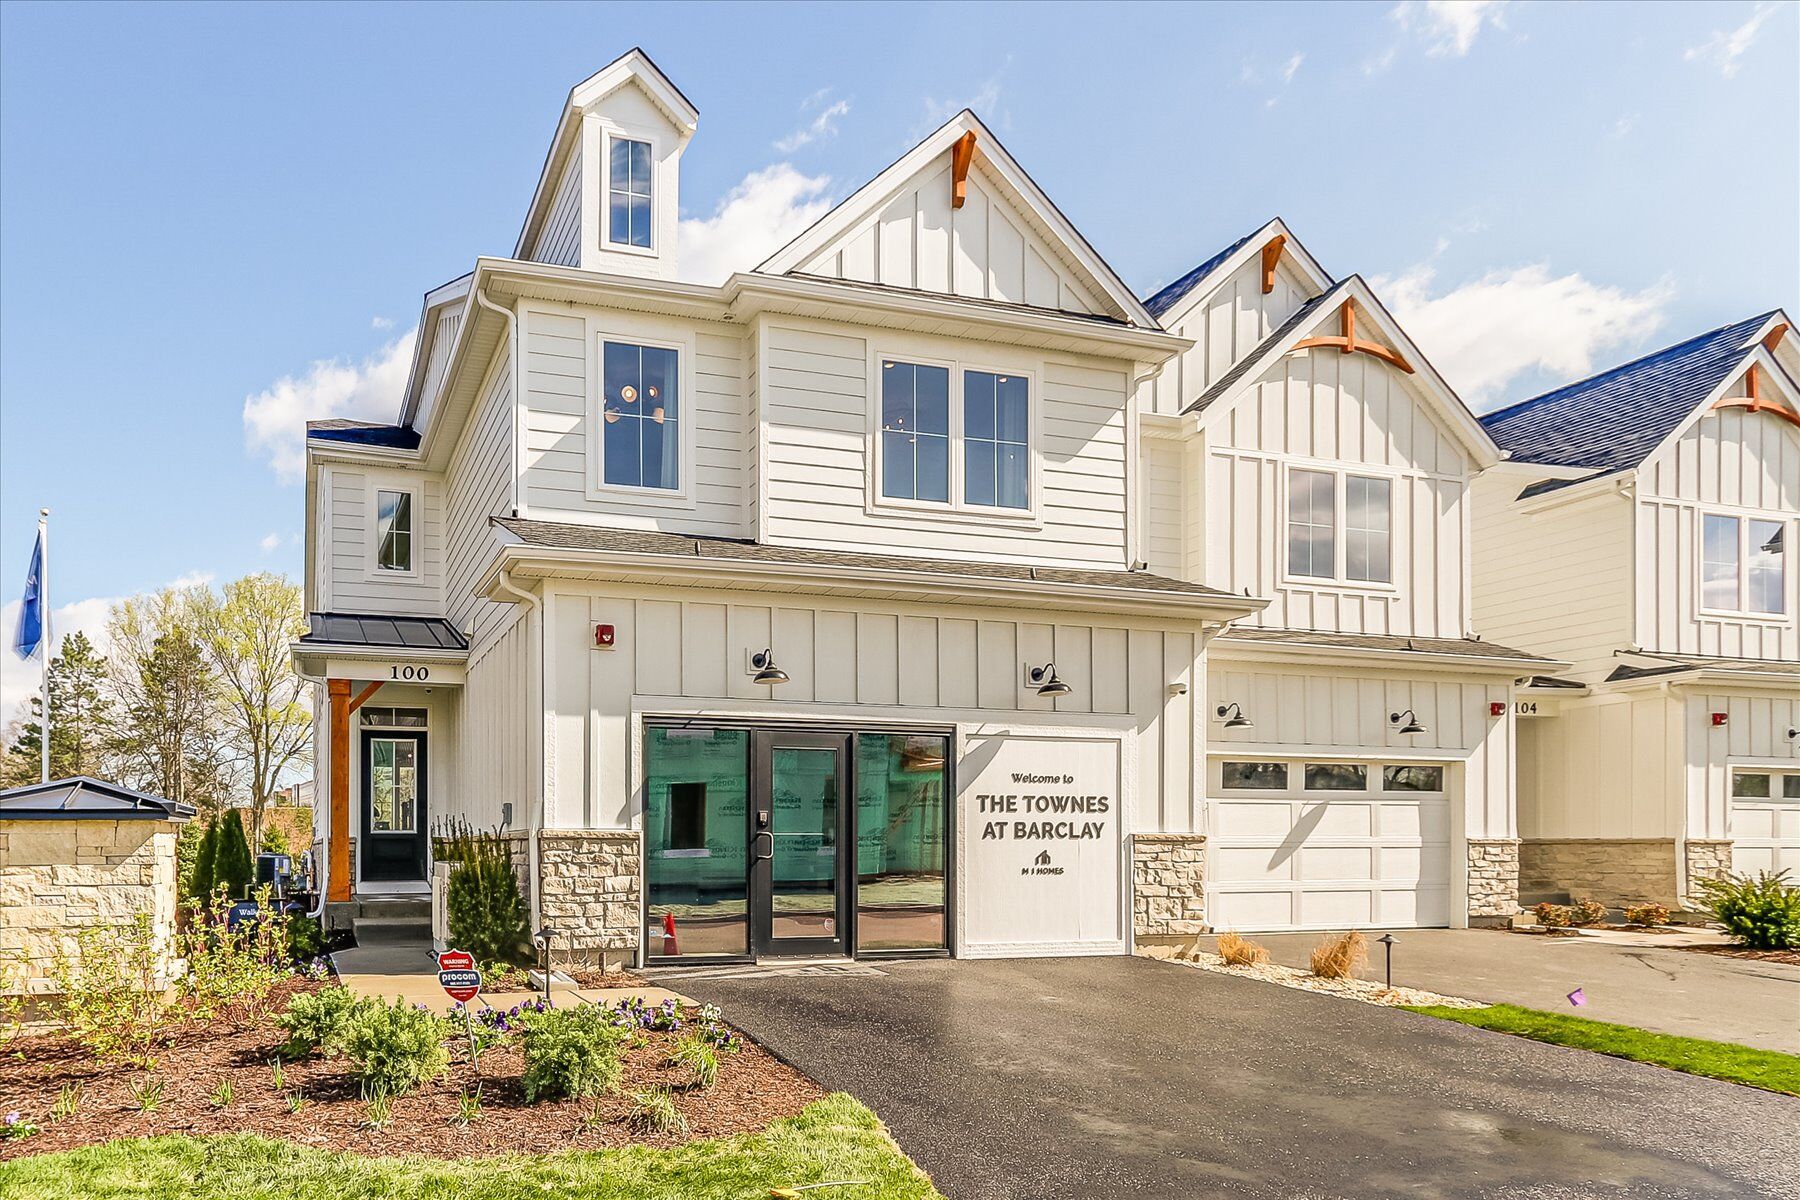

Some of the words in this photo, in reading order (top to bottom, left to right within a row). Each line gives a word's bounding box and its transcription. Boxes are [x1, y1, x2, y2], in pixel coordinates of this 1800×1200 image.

[390, 665, 429, 681] 100
[1515, 702, 1537, 714] 104
[1011, 772, 1060, 784] Welcome
[1063, 773, 1074, 784] to
[976, 795, 1018, 813] THE
[1022, 795, 1110, 814] TOWNES
[982, 822, 1008, 840] AT
[1013, 822, 1105, 840] BARCLAY
[1036, 867, 1065, 876] HOMES
[441, 973, 477, 982] procom
